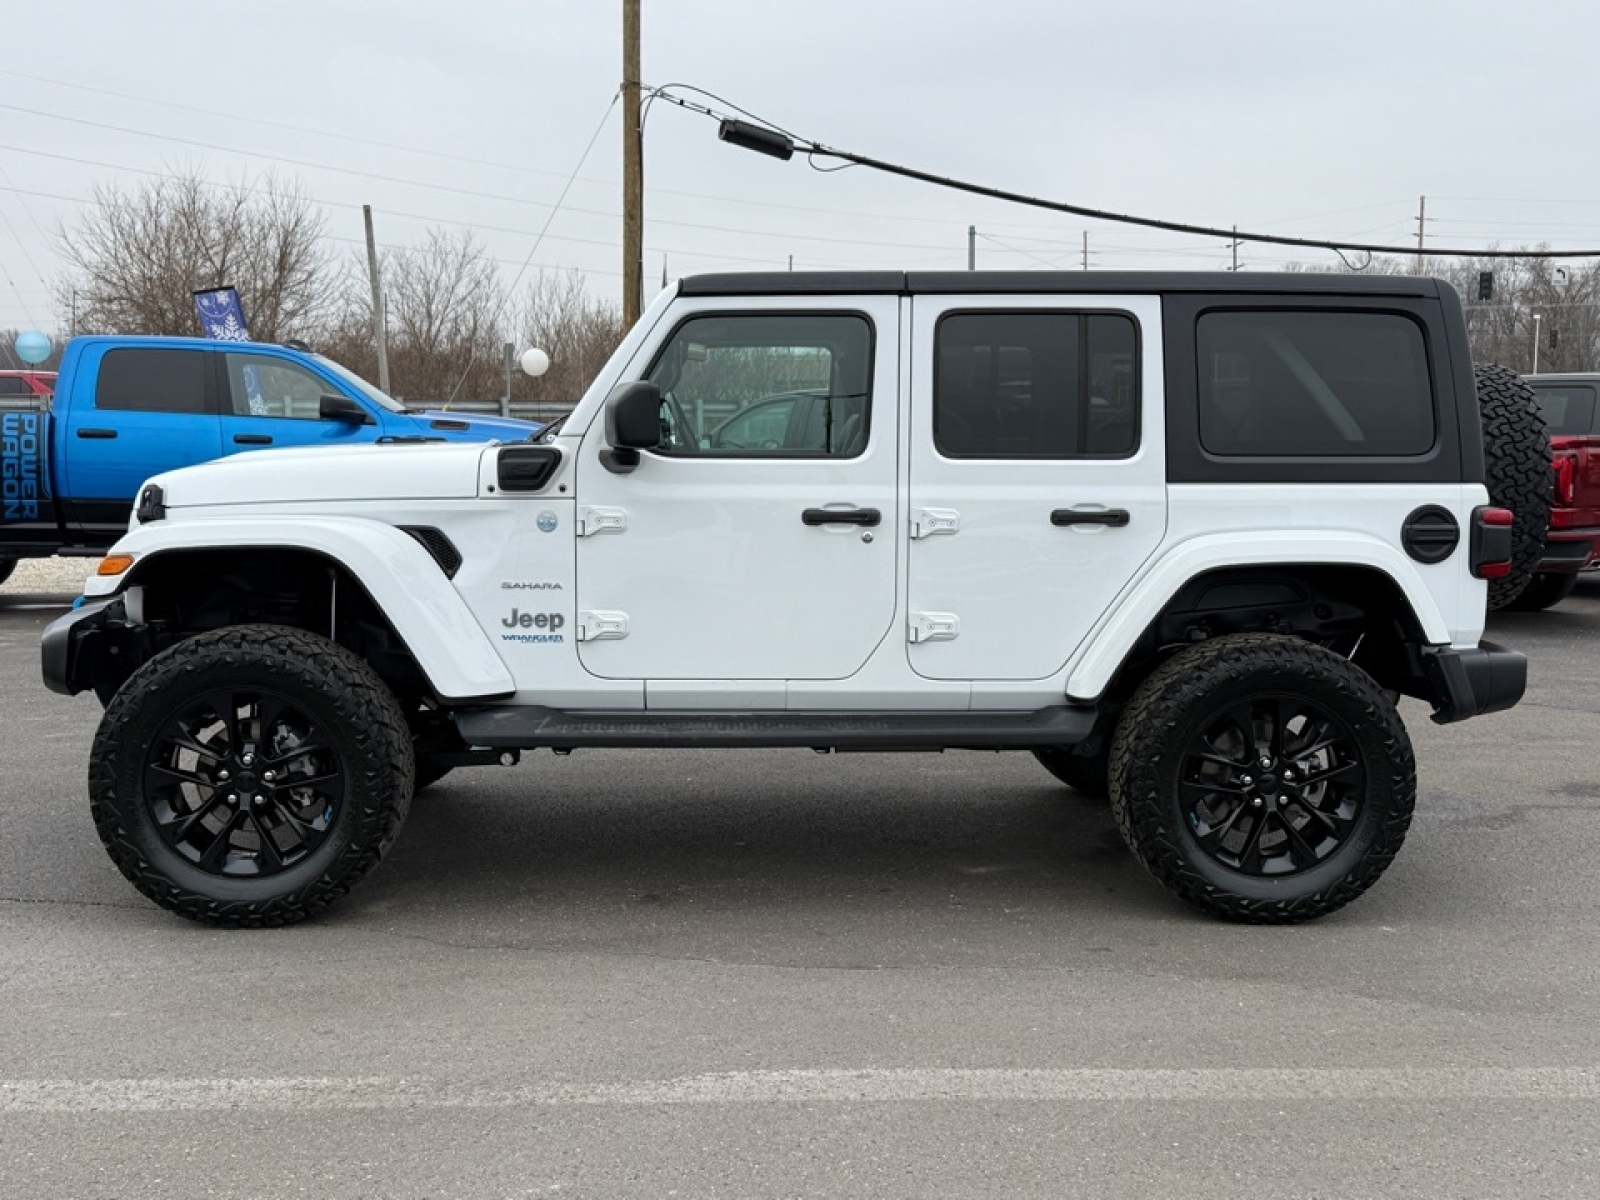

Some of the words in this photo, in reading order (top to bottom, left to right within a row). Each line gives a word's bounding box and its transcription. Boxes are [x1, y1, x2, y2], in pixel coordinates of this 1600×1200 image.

[3, 413, 19, 518] WAGON
[21, 413, 37, 519] POWER
[501, 582, 562, 590] SAHARA
[501, 608, 564, 632] Jeep
